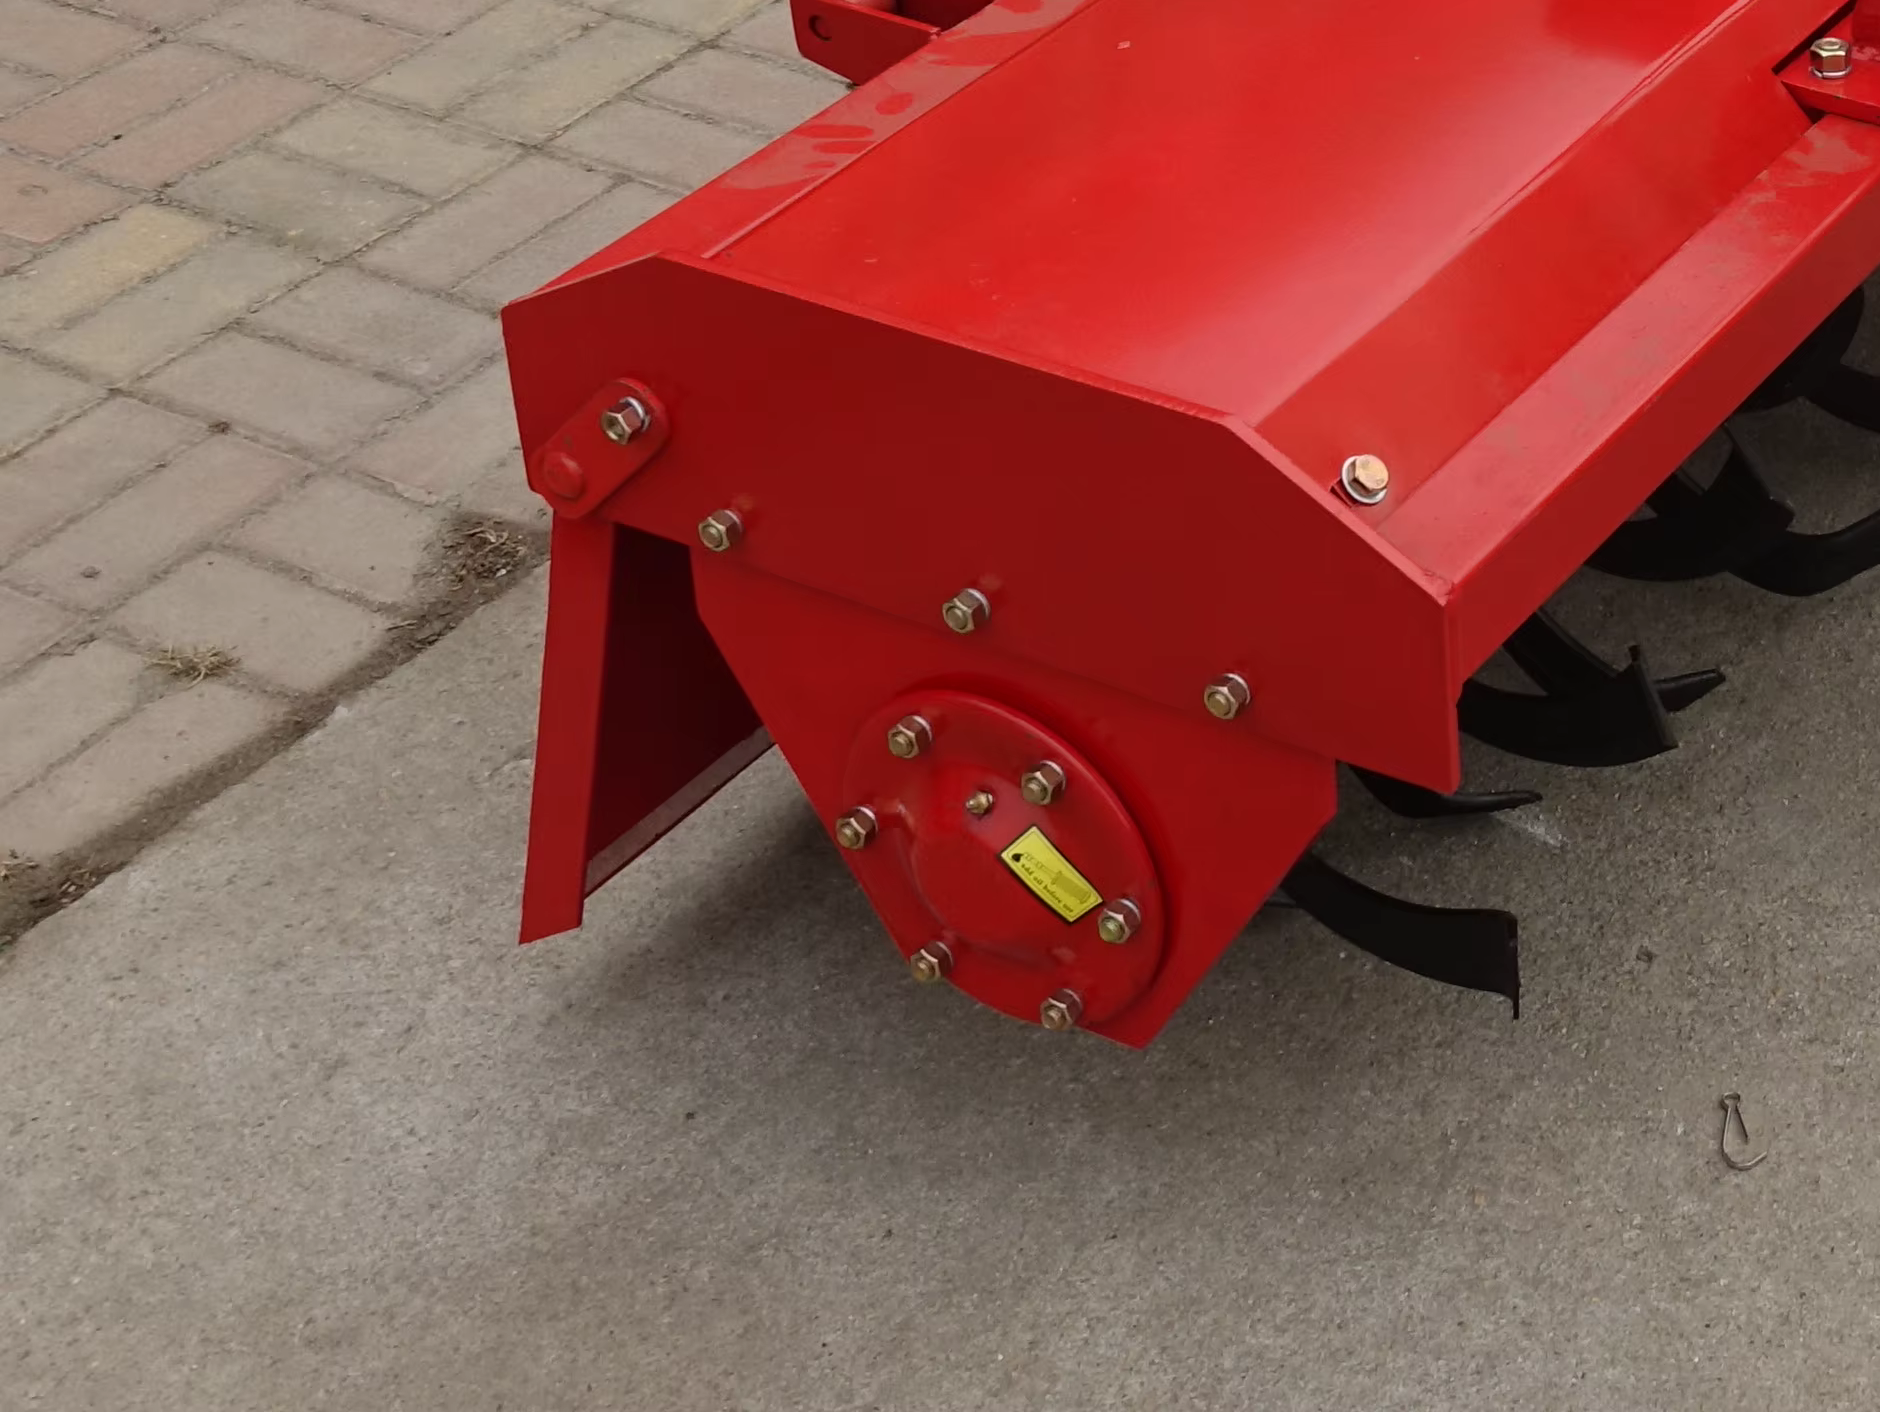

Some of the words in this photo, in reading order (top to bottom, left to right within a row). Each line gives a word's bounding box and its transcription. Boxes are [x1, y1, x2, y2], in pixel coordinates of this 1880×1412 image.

[1021, 863, 1035, 876] add
[1033, 875, 1044, 885] oil
[1043, 884, 1062, 903] before
